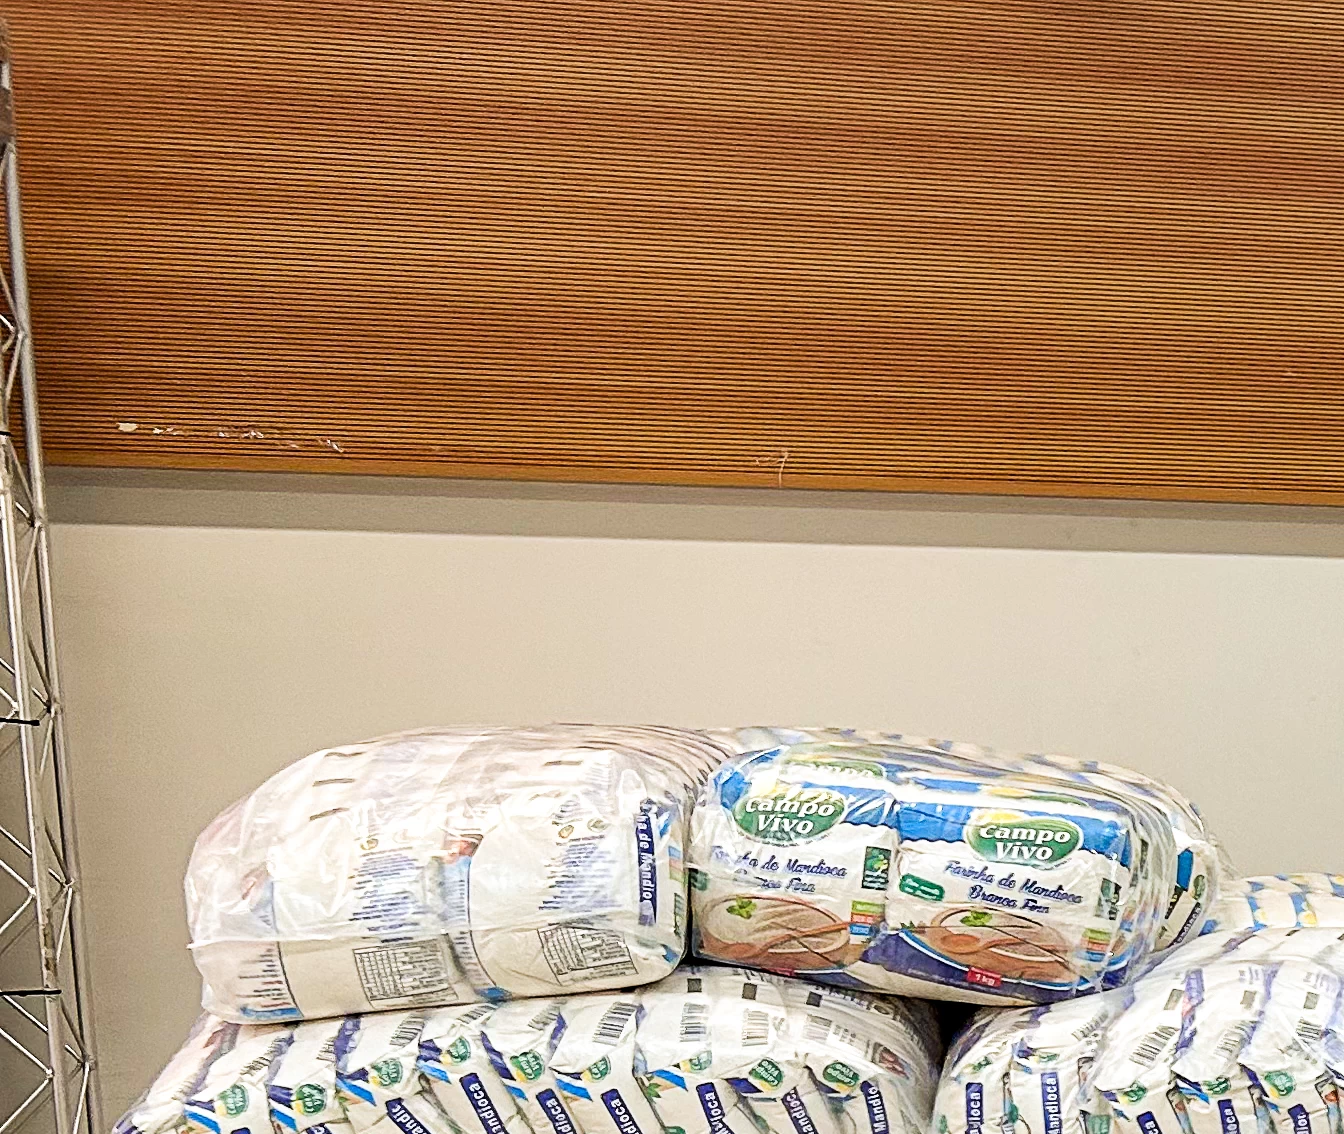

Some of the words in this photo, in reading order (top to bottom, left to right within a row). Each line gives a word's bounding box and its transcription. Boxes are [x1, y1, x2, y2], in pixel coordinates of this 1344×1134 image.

[744, 795, 837, 818] Campo
[756, 816, 814, 836] Vivo
[980, 823, 1072, 844] Campo
[995, 841, 1055, 862] Vivo
[944, 861, 996, 882] Farinha
[1001, 872, 1018, 888] de
